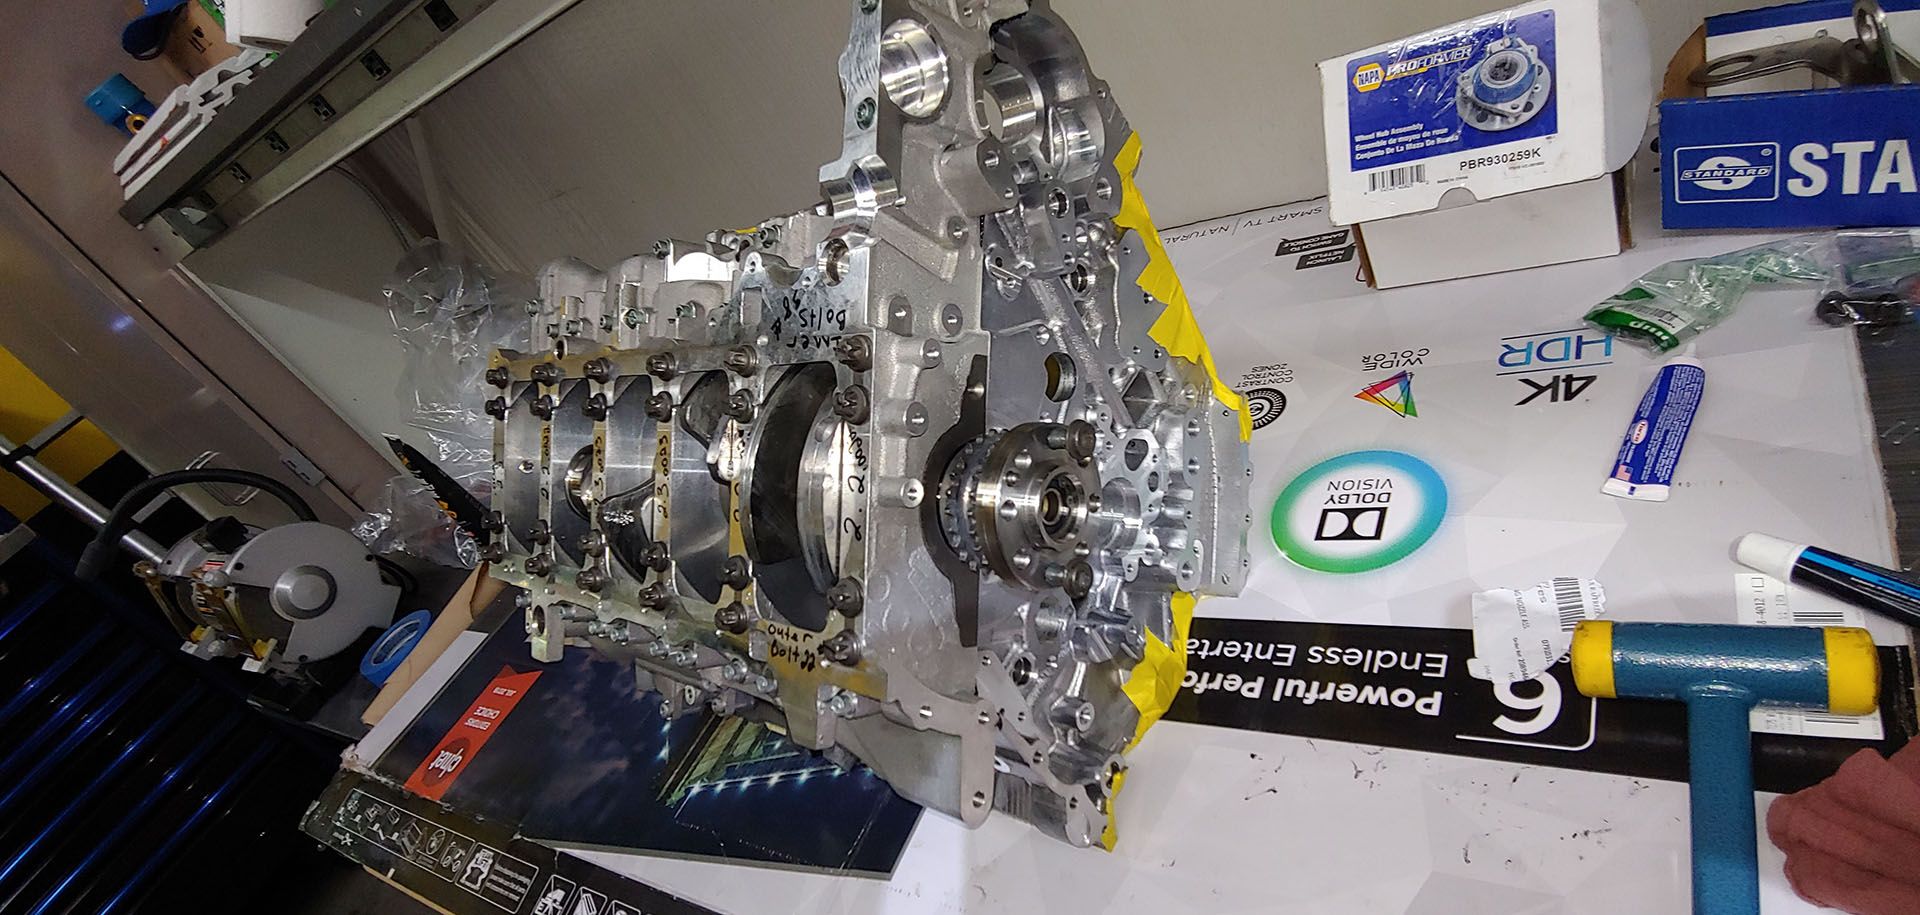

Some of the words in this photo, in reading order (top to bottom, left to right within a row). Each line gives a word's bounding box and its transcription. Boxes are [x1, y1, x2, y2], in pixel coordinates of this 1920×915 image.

[1358, 69, 1380, 86] NAPA
[1386, 47, 1472, 76] PROFORMER
[1460, 147, 1542, 171] PBR930259K
[1683, 167, 1769, 179] STANDARD
[1787, 139, 1918, 197] STA
[1267, 206, 1323, 224] SMART
[1243, 219, 1263, 228] TV
[1164, 225, 1230, 245] NATURAL
[1284, 236, 1320, 248] CONSOLE
[1320, 232, 1345, 242] GAME
[1306, 255, 1343, 266] LAUNCH
[1308, 250, 1345, 260] NETFLIX
[1361, 348, 1430, 363] COLOR
[1498, 335, 1613, 367] HDR
[1251, 363, 1288, 373] ZONES
[1362, 358, 1423, 372] WIDE
[1242, 369, 1294, 380] CONTROL
[1235, 376, 1294, 388] CONTRAST
[1514, 374, 1598, 406] 4K
[1327, 478, 1393, 491] VISION
[1324, 492, 1392, 505] DOLBY
[1186, 638, 1297, 667] Enterta
[1307, 644, 1448, 678] Endless
[1181, 670, 1265, 700] Perfo
[1273, 678, 1443, 716] Powerful
[473, 706, 500, 720] CHOICE
